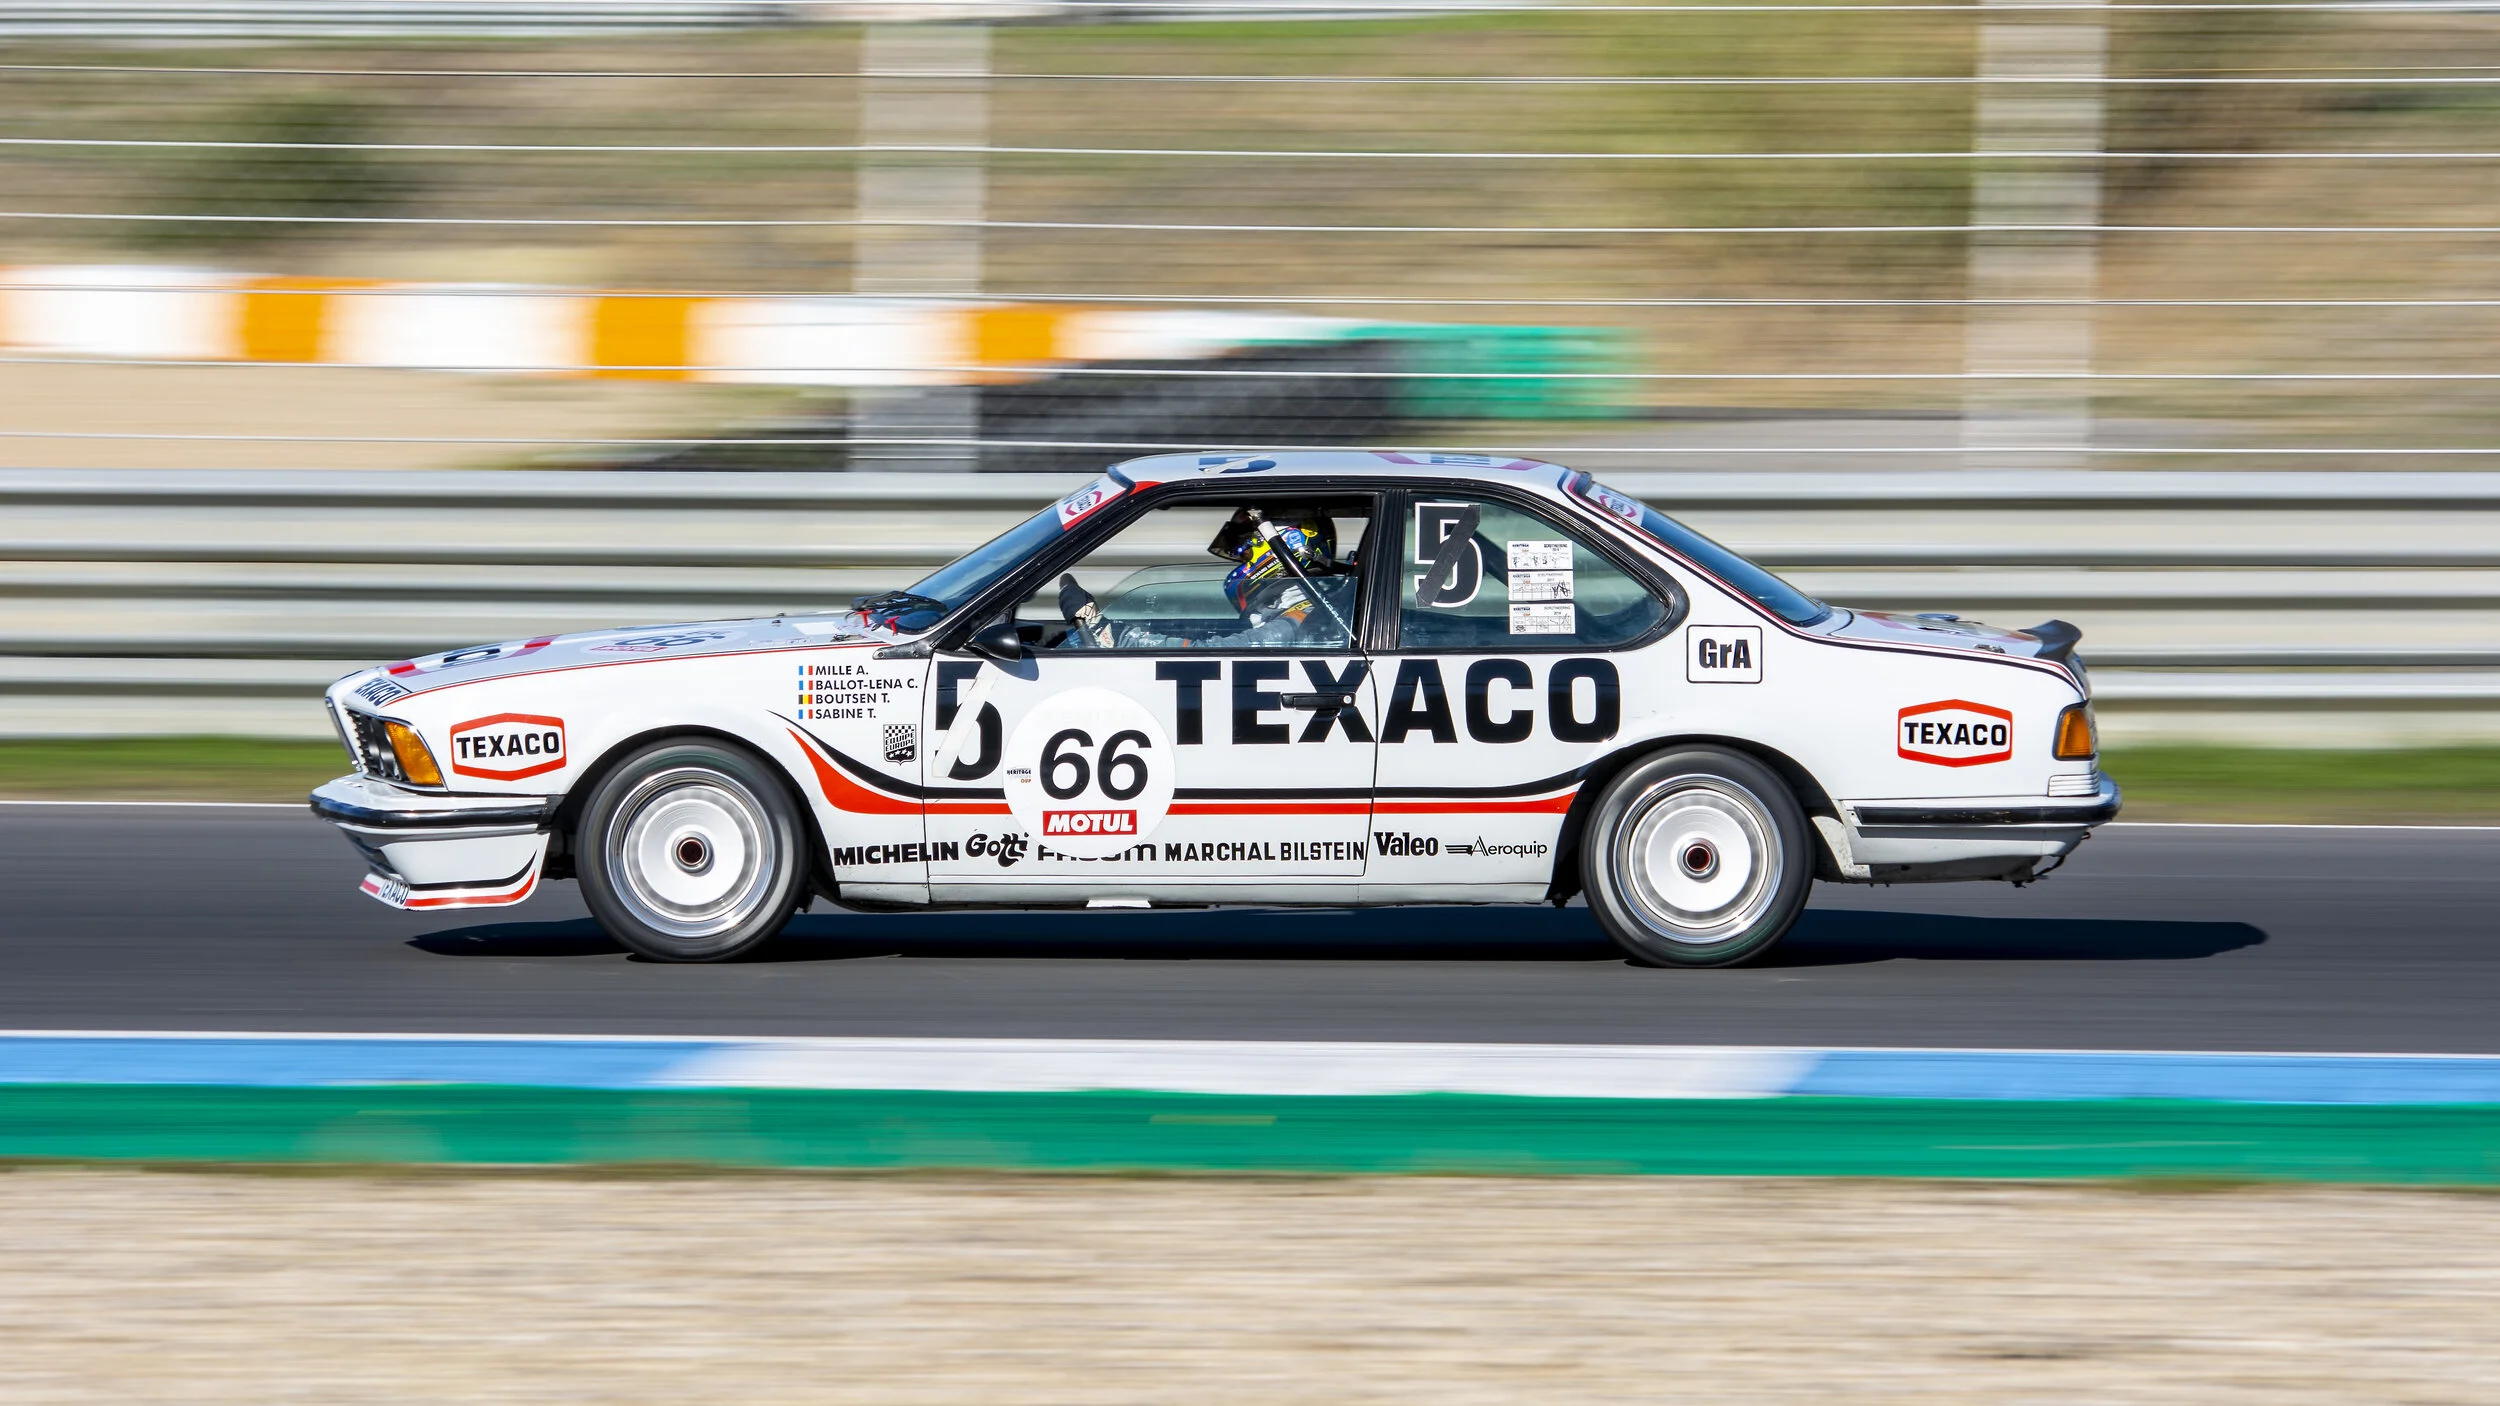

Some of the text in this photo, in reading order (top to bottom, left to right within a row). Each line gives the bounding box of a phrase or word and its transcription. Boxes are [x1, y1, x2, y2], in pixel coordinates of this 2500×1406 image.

[1414, 502, 1484, 607] 5
[1699, 638, 1752, 669] GrA
[815, 665, 869, 675] MILLE A.
[815, 678, 918, 690] BALLOT-LENA C.
[815, 693, 890, 704] BOUTSEN T.
[1155, 657, 1621, 744] TEXACO
[815, 708, 876, 719] SABINE T.
[936, 661, 1003, 780] 5
[456, 731, 560, 760] TEXACO
[885, 732, 915, 746] EQUIPE
[885, 739, 915, 752] EUROPE
[1904, 722, 2007, 746] TEXACO
[1039, 728, 1153, 801] 66
[1047, 813, 1134, 833] MOTUL
[834, 841, 959, 866] MICHELIN
[966, 831, 1029, 867] Gotti
[1165, 842, 1276, 862] MARCHAL
[1280, 841, 1365, 861] BILSTEIN
[1374, 832, 1548, 858] Valeo Aeroquip
